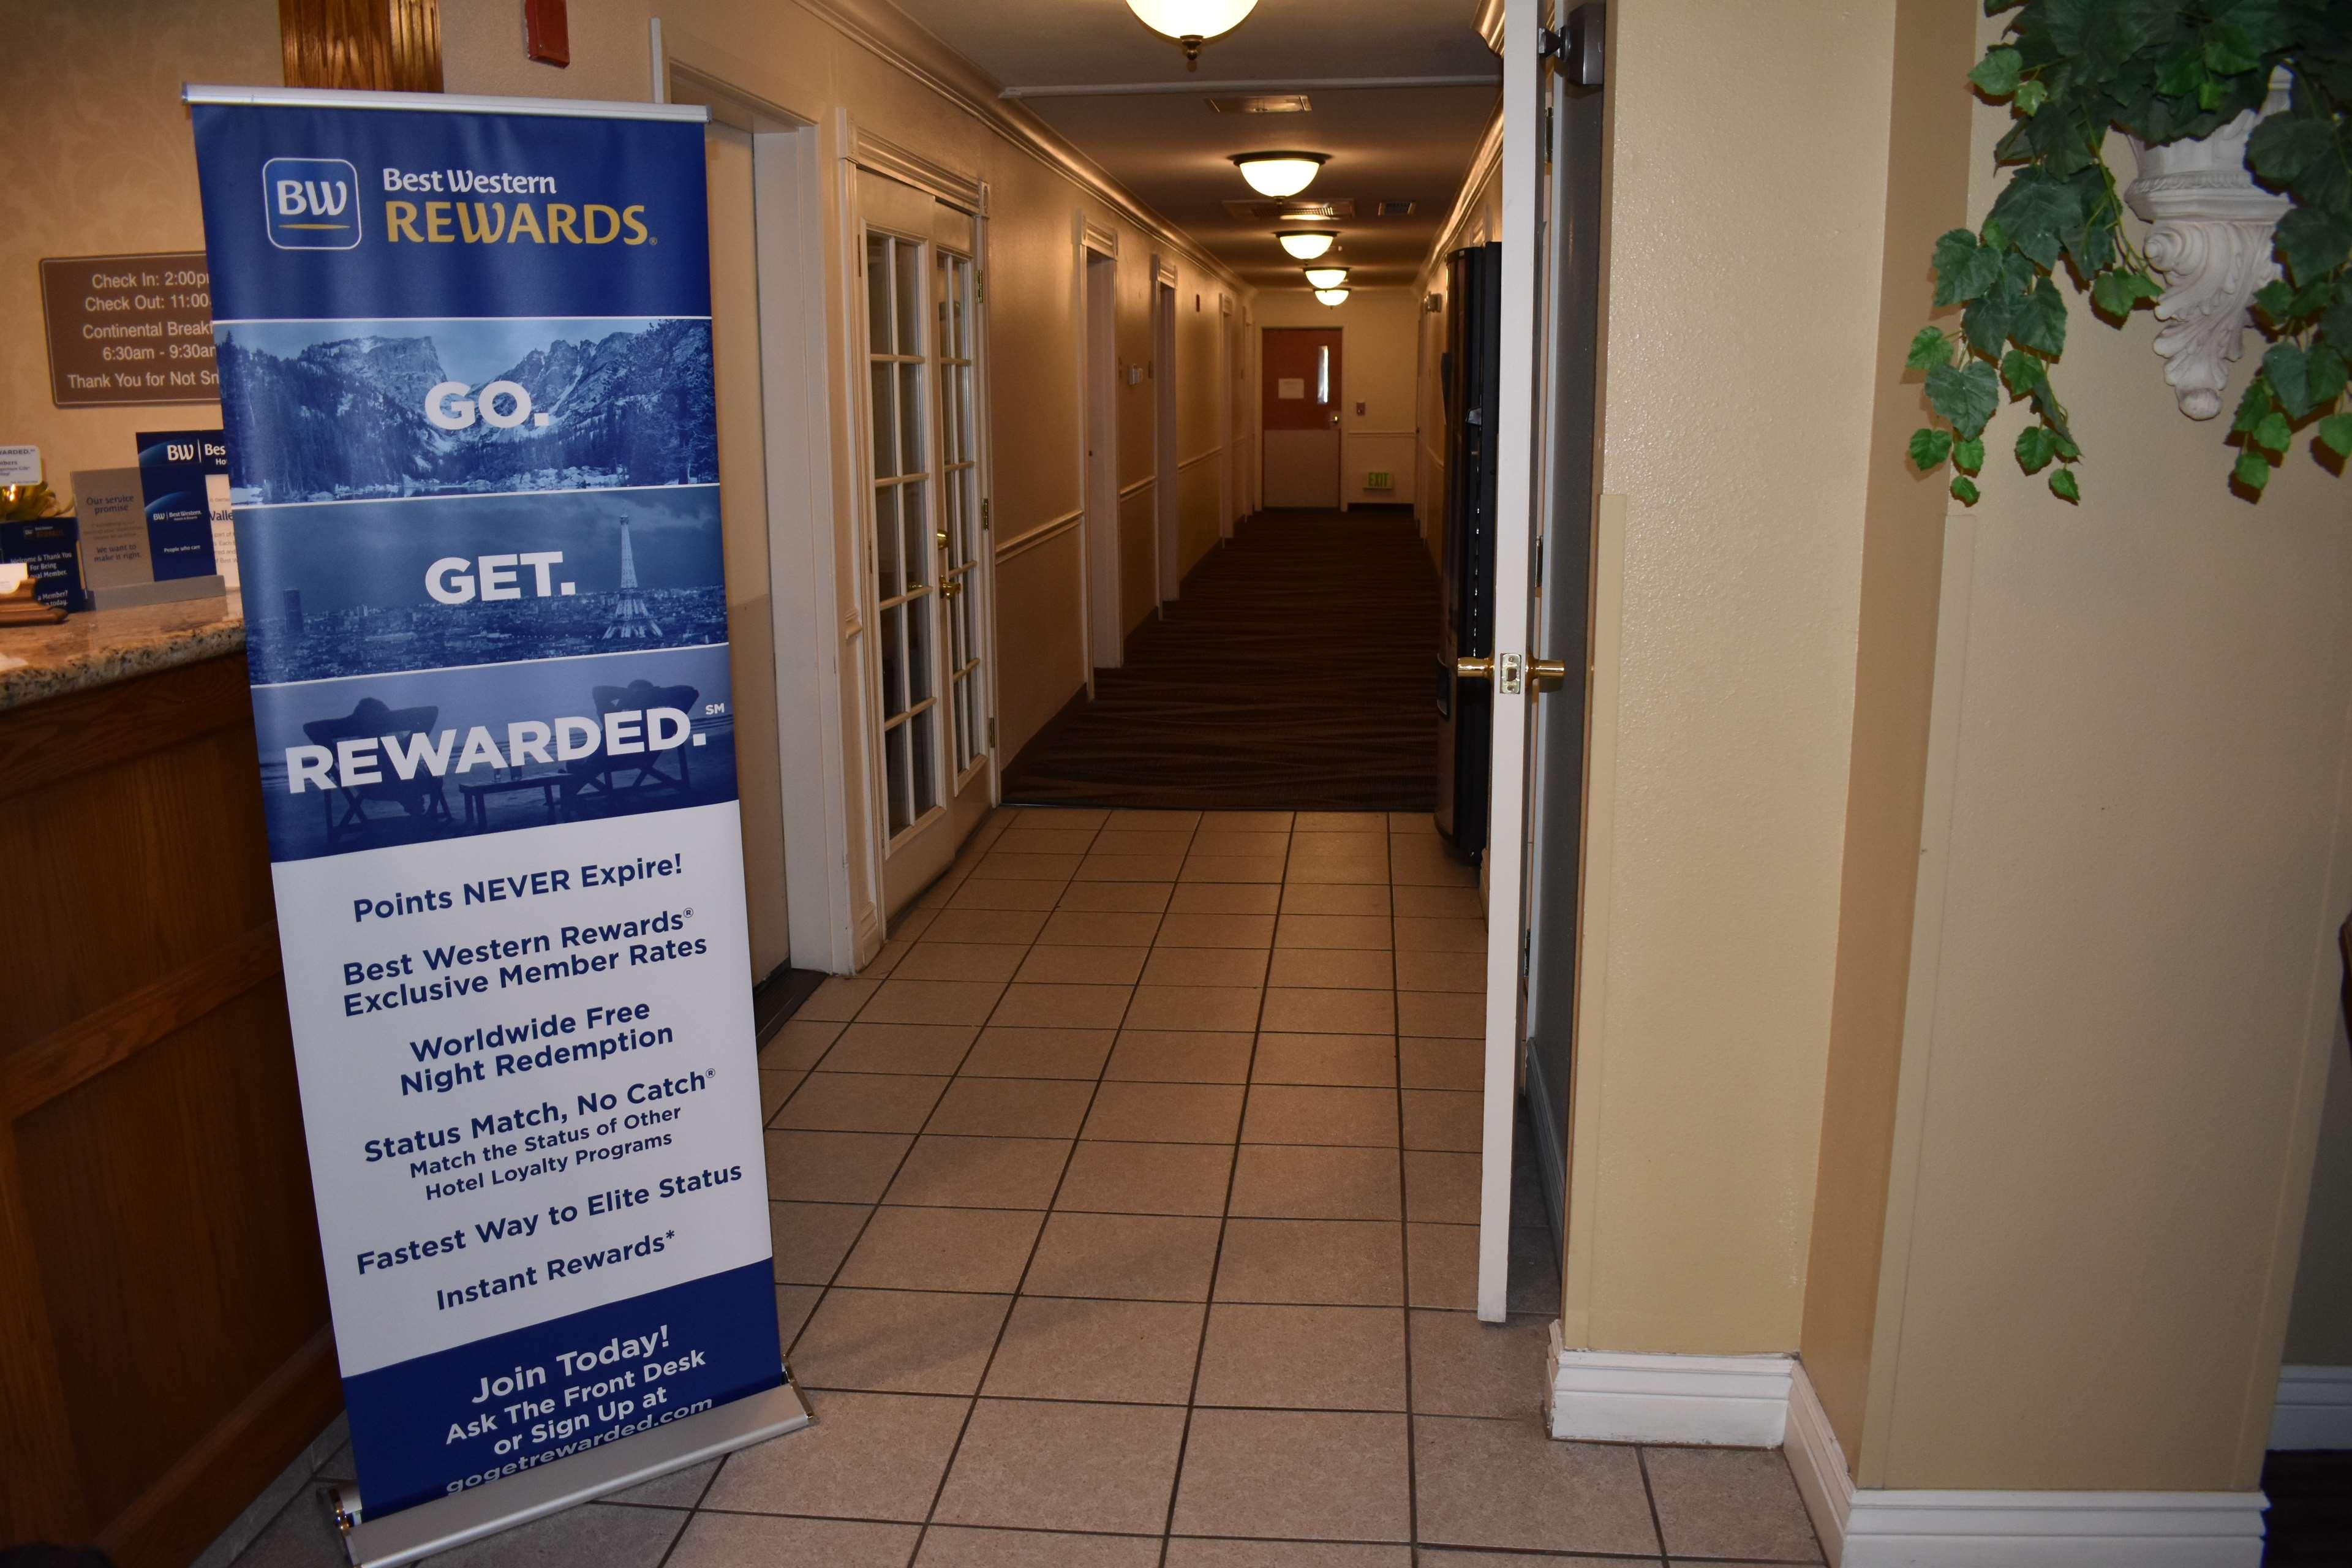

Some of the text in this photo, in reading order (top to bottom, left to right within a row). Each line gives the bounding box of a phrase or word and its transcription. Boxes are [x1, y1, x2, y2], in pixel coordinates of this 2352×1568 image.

[277, 179, 347, 216] BW
[383, 168, 557, 194] Best Western
[85, 293, 212, 312] Check Out: 11:00
[92, 271, 209, 288] Check In: 2:00p
[83, 322, 162, 339] Continental
[102, 345, 154, 361] 6:30am
[68, 373, 111, 389] Thank
[115, 372, 141, 388] You
[145, 372, 165, 386] for
[170, 371, 197, 386] Not
[424, 380, 549, 430] GO.
[167, 443, 226, 461] BW Bes
[86, 495, 134, 505] Our service
[1368, 472, 1390, 487] EXIT
[94, 505, 128, 516] promise
[210, 510, 234, 521] Valle
[425, 551, 576, 605] GET.
[354, 853, 682, 922] Points NEVER Expire!
[344, 953, 413, 986] Best
[423, 935, 549, 971] Western
[344, 937, 707, 1017] Exclusive Member Rates
[409, 1003, 650, 1062] Worldwide Free
[401, 1025, 673, 1096] Night Redemption
[364, 1123, 461, 1163] Status
[472, 1102, 568, 1139] Match,
[578, 1092, 617, 1116] No
[410, 1106, 682, 1178] Match the Status of Other
[426, 1133, 673, 1200] Hotel Loyalty Programs
[357, 1166, 742, 1275] Fastest Way to Elite Status
[437, 1267, 537, 1311] Instant
[472, 1325, 669, 1403] Join Today!
[447, 1350, 706, 1444] Ask The Front Desk
[494, 1387, 667, 1455] or Sign Up at
[446, 1398, 713, 1496] gogetrewarded.com
